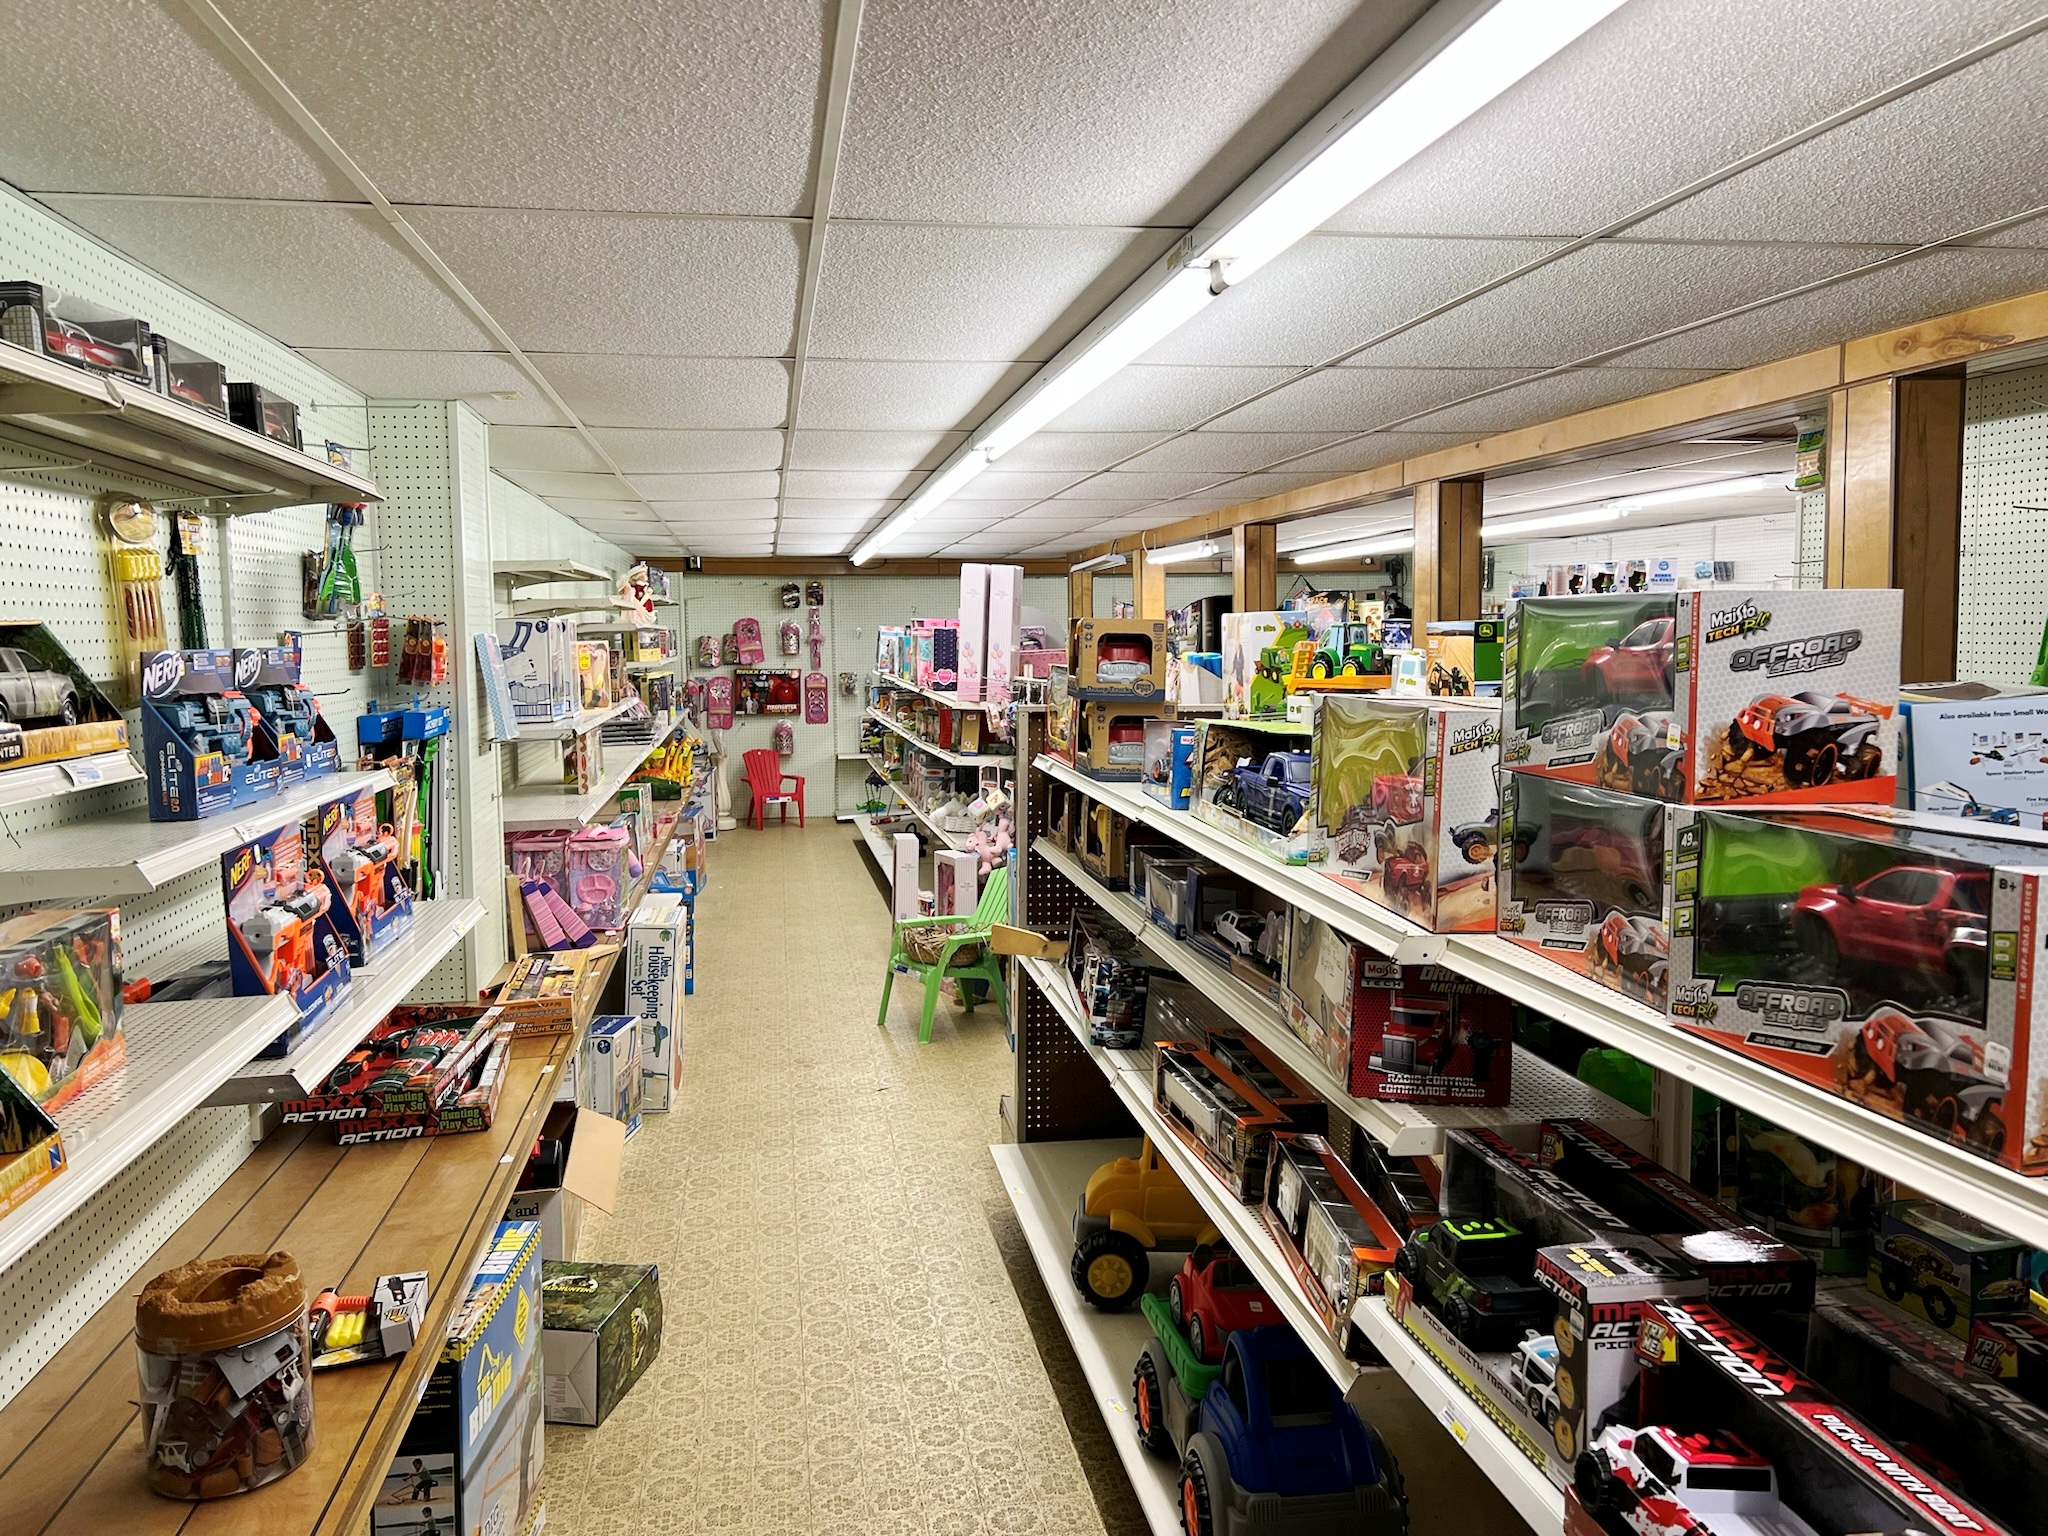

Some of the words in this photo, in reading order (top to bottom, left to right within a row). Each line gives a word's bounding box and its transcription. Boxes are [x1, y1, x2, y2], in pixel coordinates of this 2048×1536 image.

[1680, 599, 1690, 608] 8+
[1710, 600, 1757, 629] Maisto
[1707, 625, 1740, 642] TECH
[1742, 611, 1771, 639] R/C
[1731, 630, 1862, 672] OFFROAD
[235, 650, 262, 684] NERF
[1767, 650, 1848, 677] SERIES
[143, 652, 184, 697] NERF
[1087, 685, 1109, 694] Dump
[1429, 717, 1437, 727] 8+
[1957, 711, 1991, 720] available
[1993, 710, 2011, 718] from
[2013, 708, 2034, 717] Small
[1453, 720, 1494, 744] Maisto
[1542, 715, 1599, 743] OFFROAD
[1450, 740, 1480, 755] TECH
[1559, 734, 1591, 747] SERIES
[158, 750, 168, 792] COMMANDER
[166, 741, 180, 798] ELITE
[245, 768, 273, 785] ELITE
[322, 803, 339, 835] NERF
[1680, 832, 1694, 847] 49
[229, 848, 252, 890] NERF
[1997, 878, 2017, 893] 8+
[2023, 882, 2034, 921] SERIES
[1536, 906, 1590, 922] OFFROAD
[1678, 910, 1691, 928] 2
[1552, 921, 1583, 931] SERIES
[2019, 924, 2031, 979] OFF-ROAD
[660, 956, 672, 978] Deluxe
[1368, 963, 1399, 977] Maisto
[631, 979, 646, 996] Set
[641, 945, 666, 1020] Housekeeping
[1366, 979, 1401, 987] TECH
[1428, 982, 1474, 994] RACING
[1675, 983, 1708, 1005] Maisto
[1738, 987, 1843, 1018] OFFROAD
[1672, 1003, 1696, 1016] TECH
[1766, 1011, 1827, 1028] SERIES
[384, 1091, 424, 1104] Hunting
[1378, 1083, 1448, 1097] COMMANDE
[1451, 1087, 1486, 1098] RADIO
[282, 1094, 365, 1113] MAXX
[383, 1102, 406, 1114] Play
[410, 1099, 428, 1111] Set
[440, 1107, 480, 1121] Hunting
[281, 1107, 368, 1124] ACTION
[339, 1115, 421, 1134] MAXX
[439, 1119, 461, 1131] Play
[466, 1116, 483, 1128] Set
[338, 1125, 425, 1146] ACTION
[1551, 1122, 1632, 1170] ACTION
[1468, 1127, 1537, 1168] MAXX
[1528, 1167, 1631, 1229] ACTION
[515, 1203, 540, 1218] and
[478, 1250, 520, 1275] BIG
[1535, 1254, 1584, 1298] MAXX
[1533, 1269, 1583, 1311] ACTION
[1708, 1281, 1793, 1298] ACTION
[1592, 1302, 1644, 1322] MA
[1645, 1319, 1666, 1337] TRY
[1655, 1298, 1785, 1397] ACTION
[1681, 1303, 1816, 1394] MAXX
[1974, 1336, 2005, 1360] TRY
[1421, 1310, 1457, 1347] PICK-UP
[1458, 1345, 1484, 1373] WITH
[1486, 1372, 1529, 1418] TRAILER
[1970, 1353, 1997, 1372] ME!
[477, 1369, 492, 1402] THE
[468, 1386, 493, 1448] BIG
[491, 1352, 513, 1411] DIG
[1473, 1383, 1517, 1432] SPORTSMAN
[1517, 1426, 1547, 1462] SERIES
[1812, 1413, 1891, 1463] PICK-UP
[1875, 1460, 1933, 1495] WITH
[1915, 1492, 1985, 1532] BOAT
